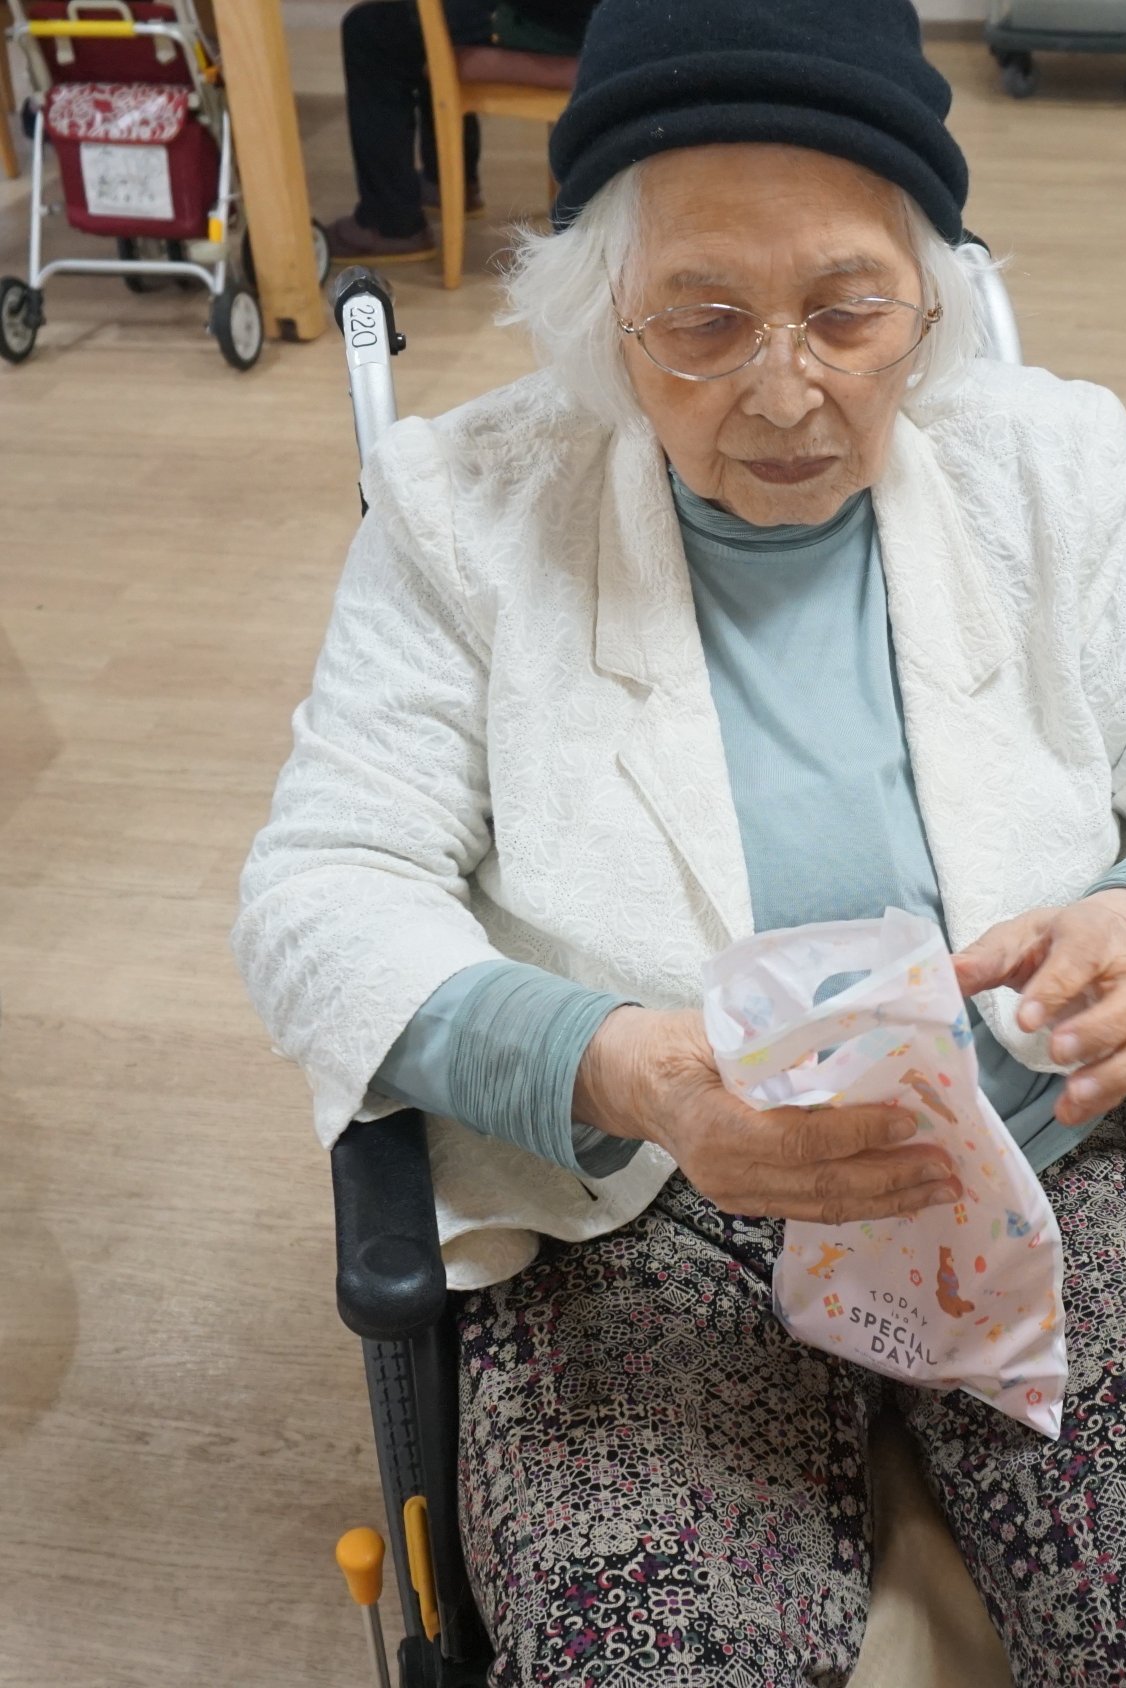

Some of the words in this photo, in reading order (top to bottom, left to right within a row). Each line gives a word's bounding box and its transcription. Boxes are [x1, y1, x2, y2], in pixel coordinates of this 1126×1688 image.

[350, 304, 378, 348] 220
[869, 1290, 928, 1327] TODAY
[891, 1309, 900, 1320] is
[903, 1316, 909, 1324] a
[849, 1306, 938, 1366] SPECIAL
[871, 1335, 916, 1369] DAY
